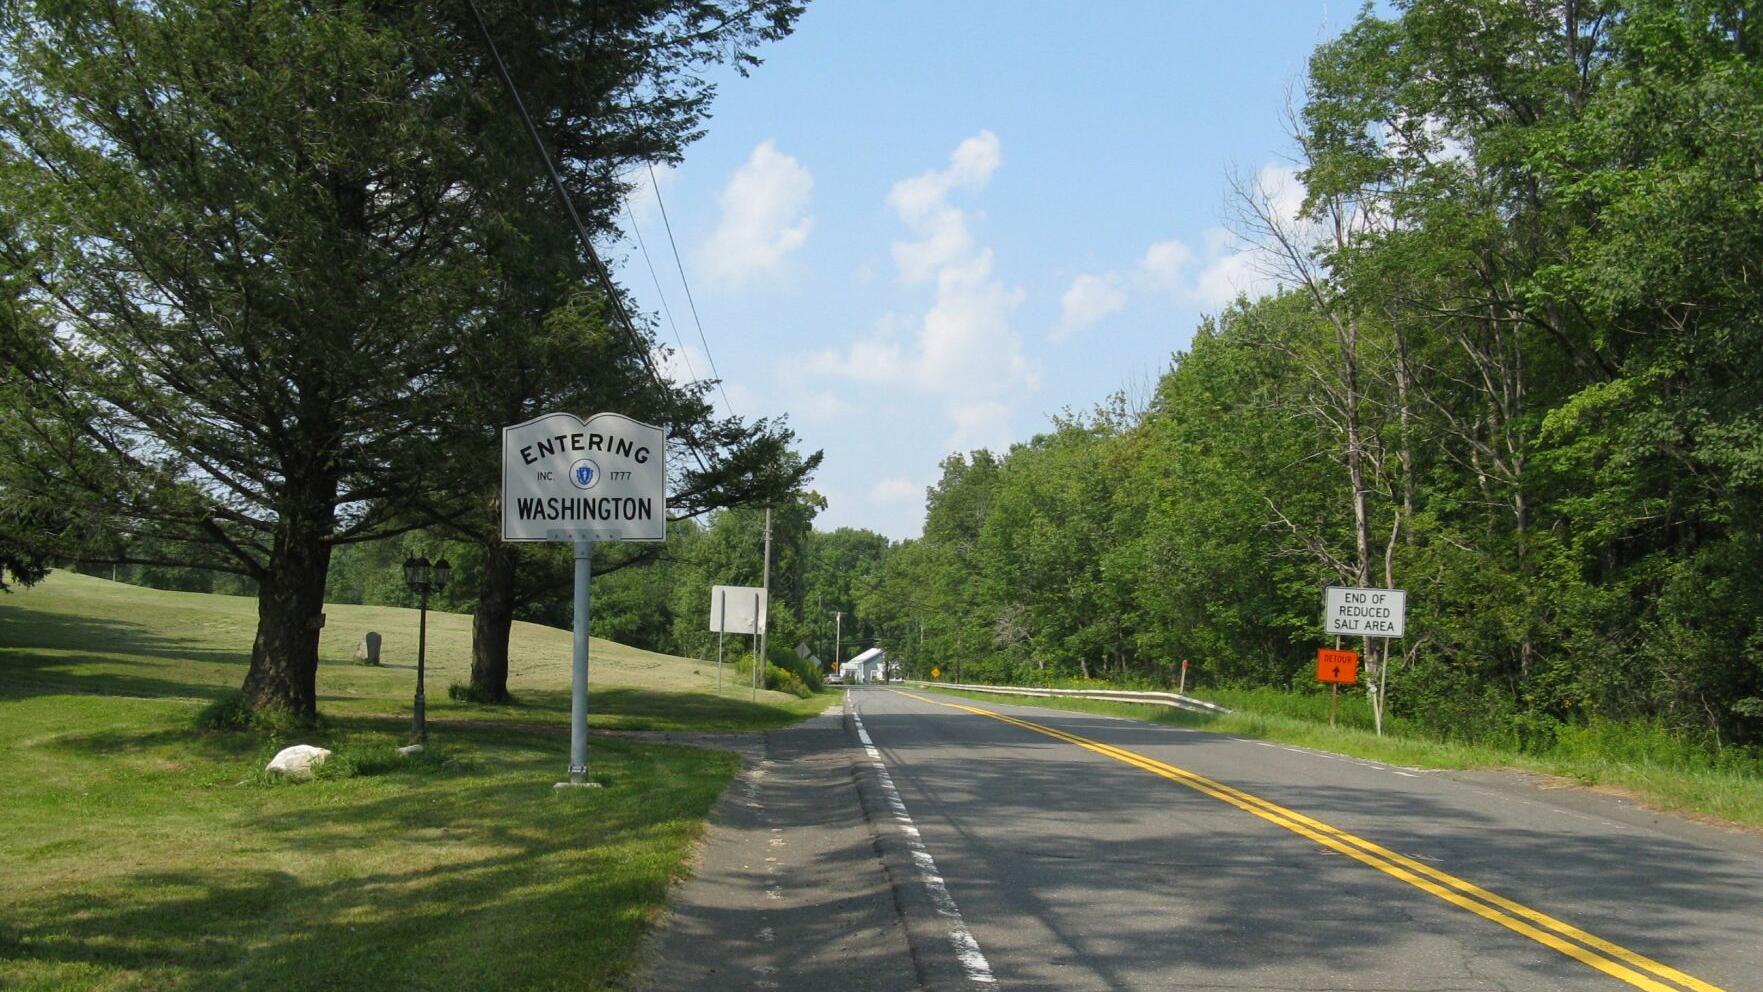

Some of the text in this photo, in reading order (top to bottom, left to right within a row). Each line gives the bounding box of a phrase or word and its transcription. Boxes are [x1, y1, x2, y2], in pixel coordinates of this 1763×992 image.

[520, 433, 650, 465] ENTERING
[610, 471, 632, 481] 1777
[517, 498, 651, 520] WASHINGTON
[1345, 593, 1386, 604] END OF
[1340, 606, 1390, 617] REDUCED
[1334, 619, 1394, 631] SALT AREA
[1324, 655, 1352, 663] DETOUR
